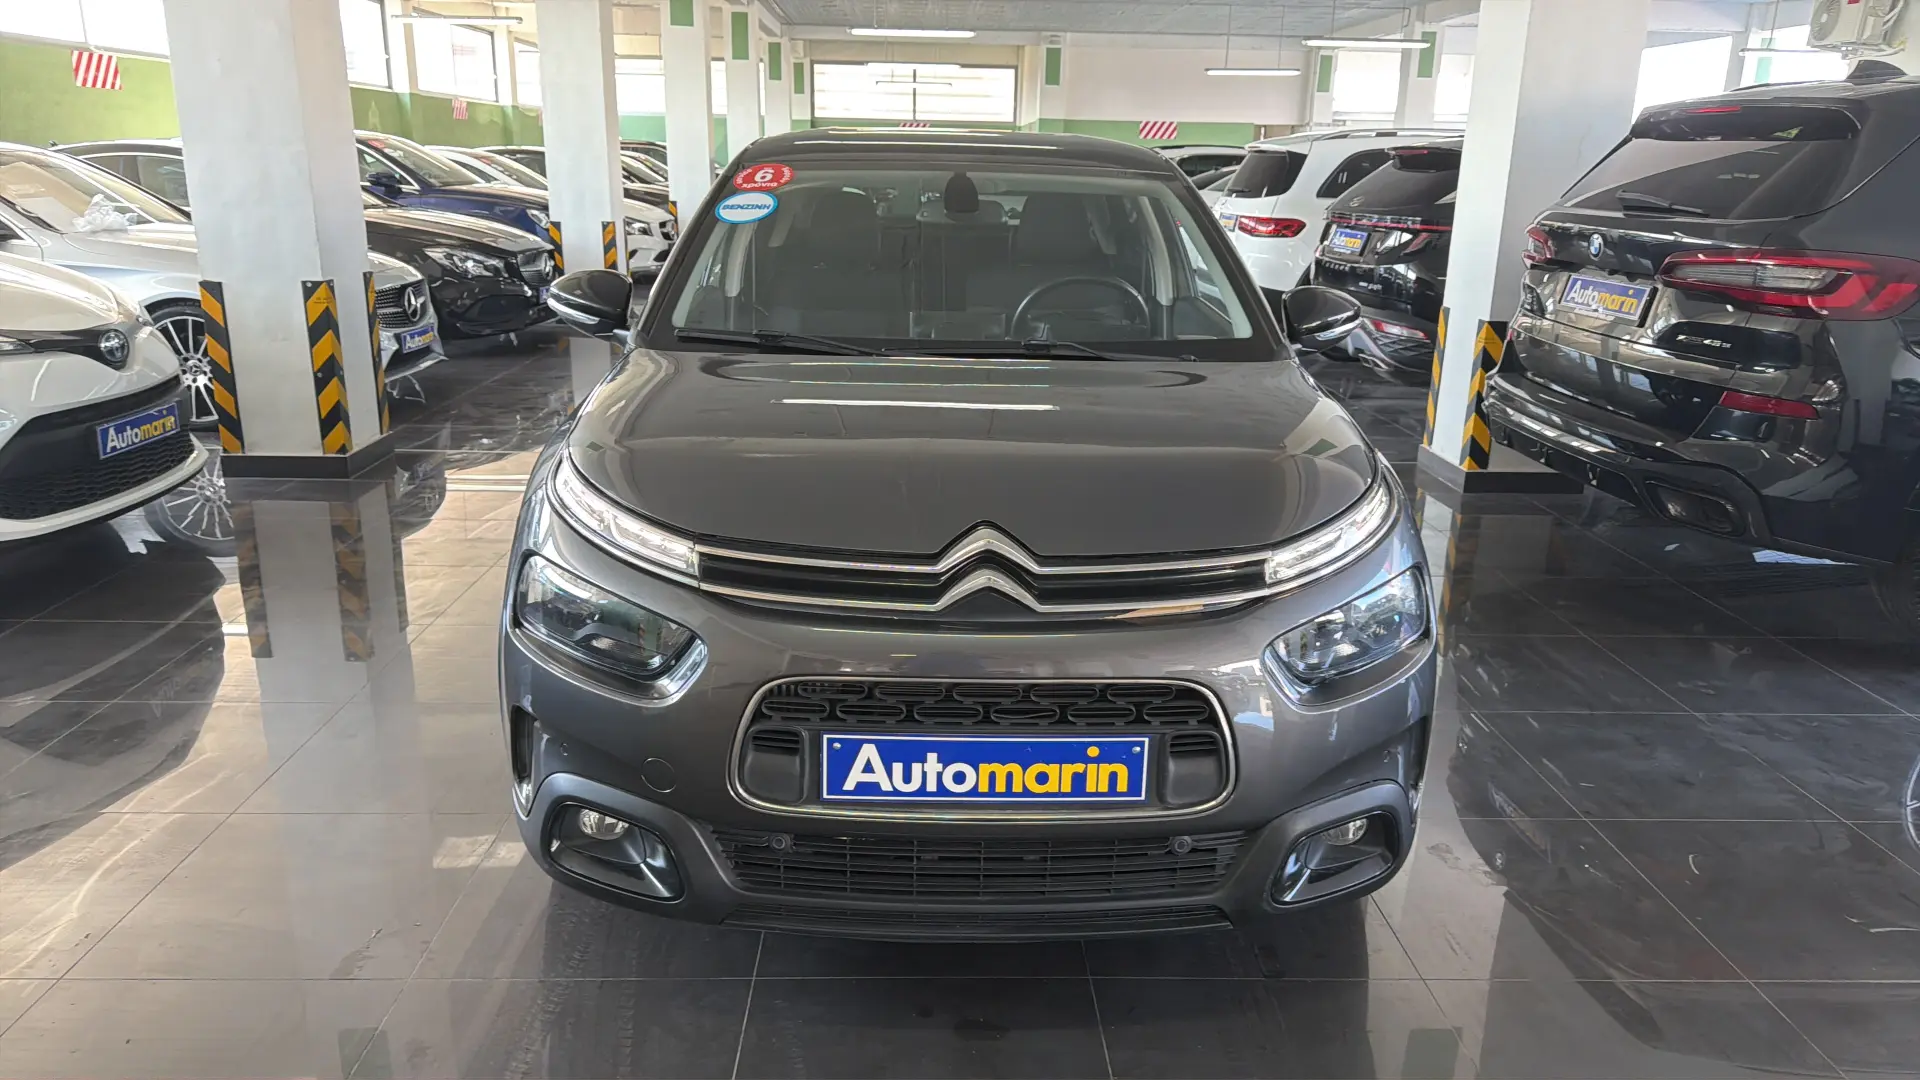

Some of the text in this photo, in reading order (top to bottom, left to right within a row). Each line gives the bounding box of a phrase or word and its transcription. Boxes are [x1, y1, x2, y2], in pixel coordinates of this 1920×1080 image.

[754, 169, 775, 182] 6
[1567, 280, 1639, 314] Automarin
[106, 409, 176, 453] Automarin
[842, 743, 1129, 793] Automarin
